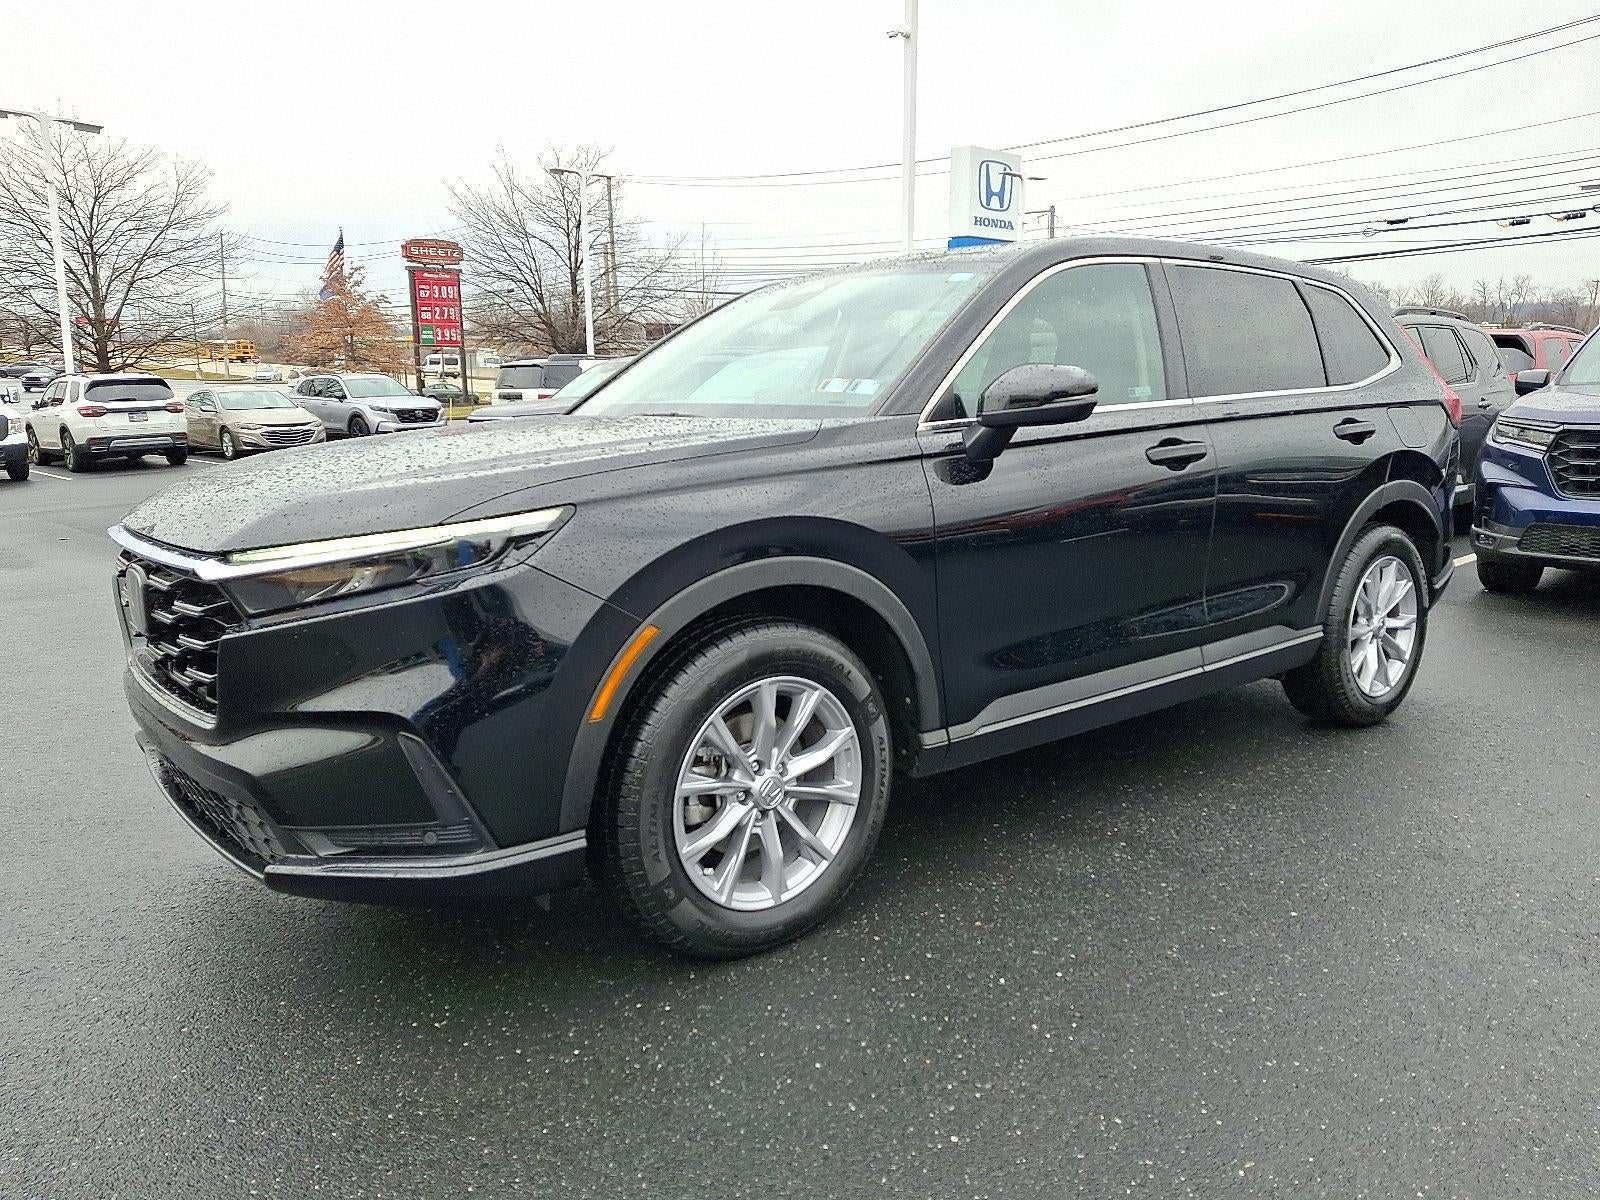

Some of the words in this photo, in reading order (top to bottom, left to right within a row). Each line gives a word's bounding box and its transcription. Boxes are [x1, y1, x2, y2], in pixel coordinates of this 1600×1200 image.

[973, 215, 1015, 231] HONDA
[410, 246, 460, 258] SHEETZ
[419, 290, 431, 298] 87
